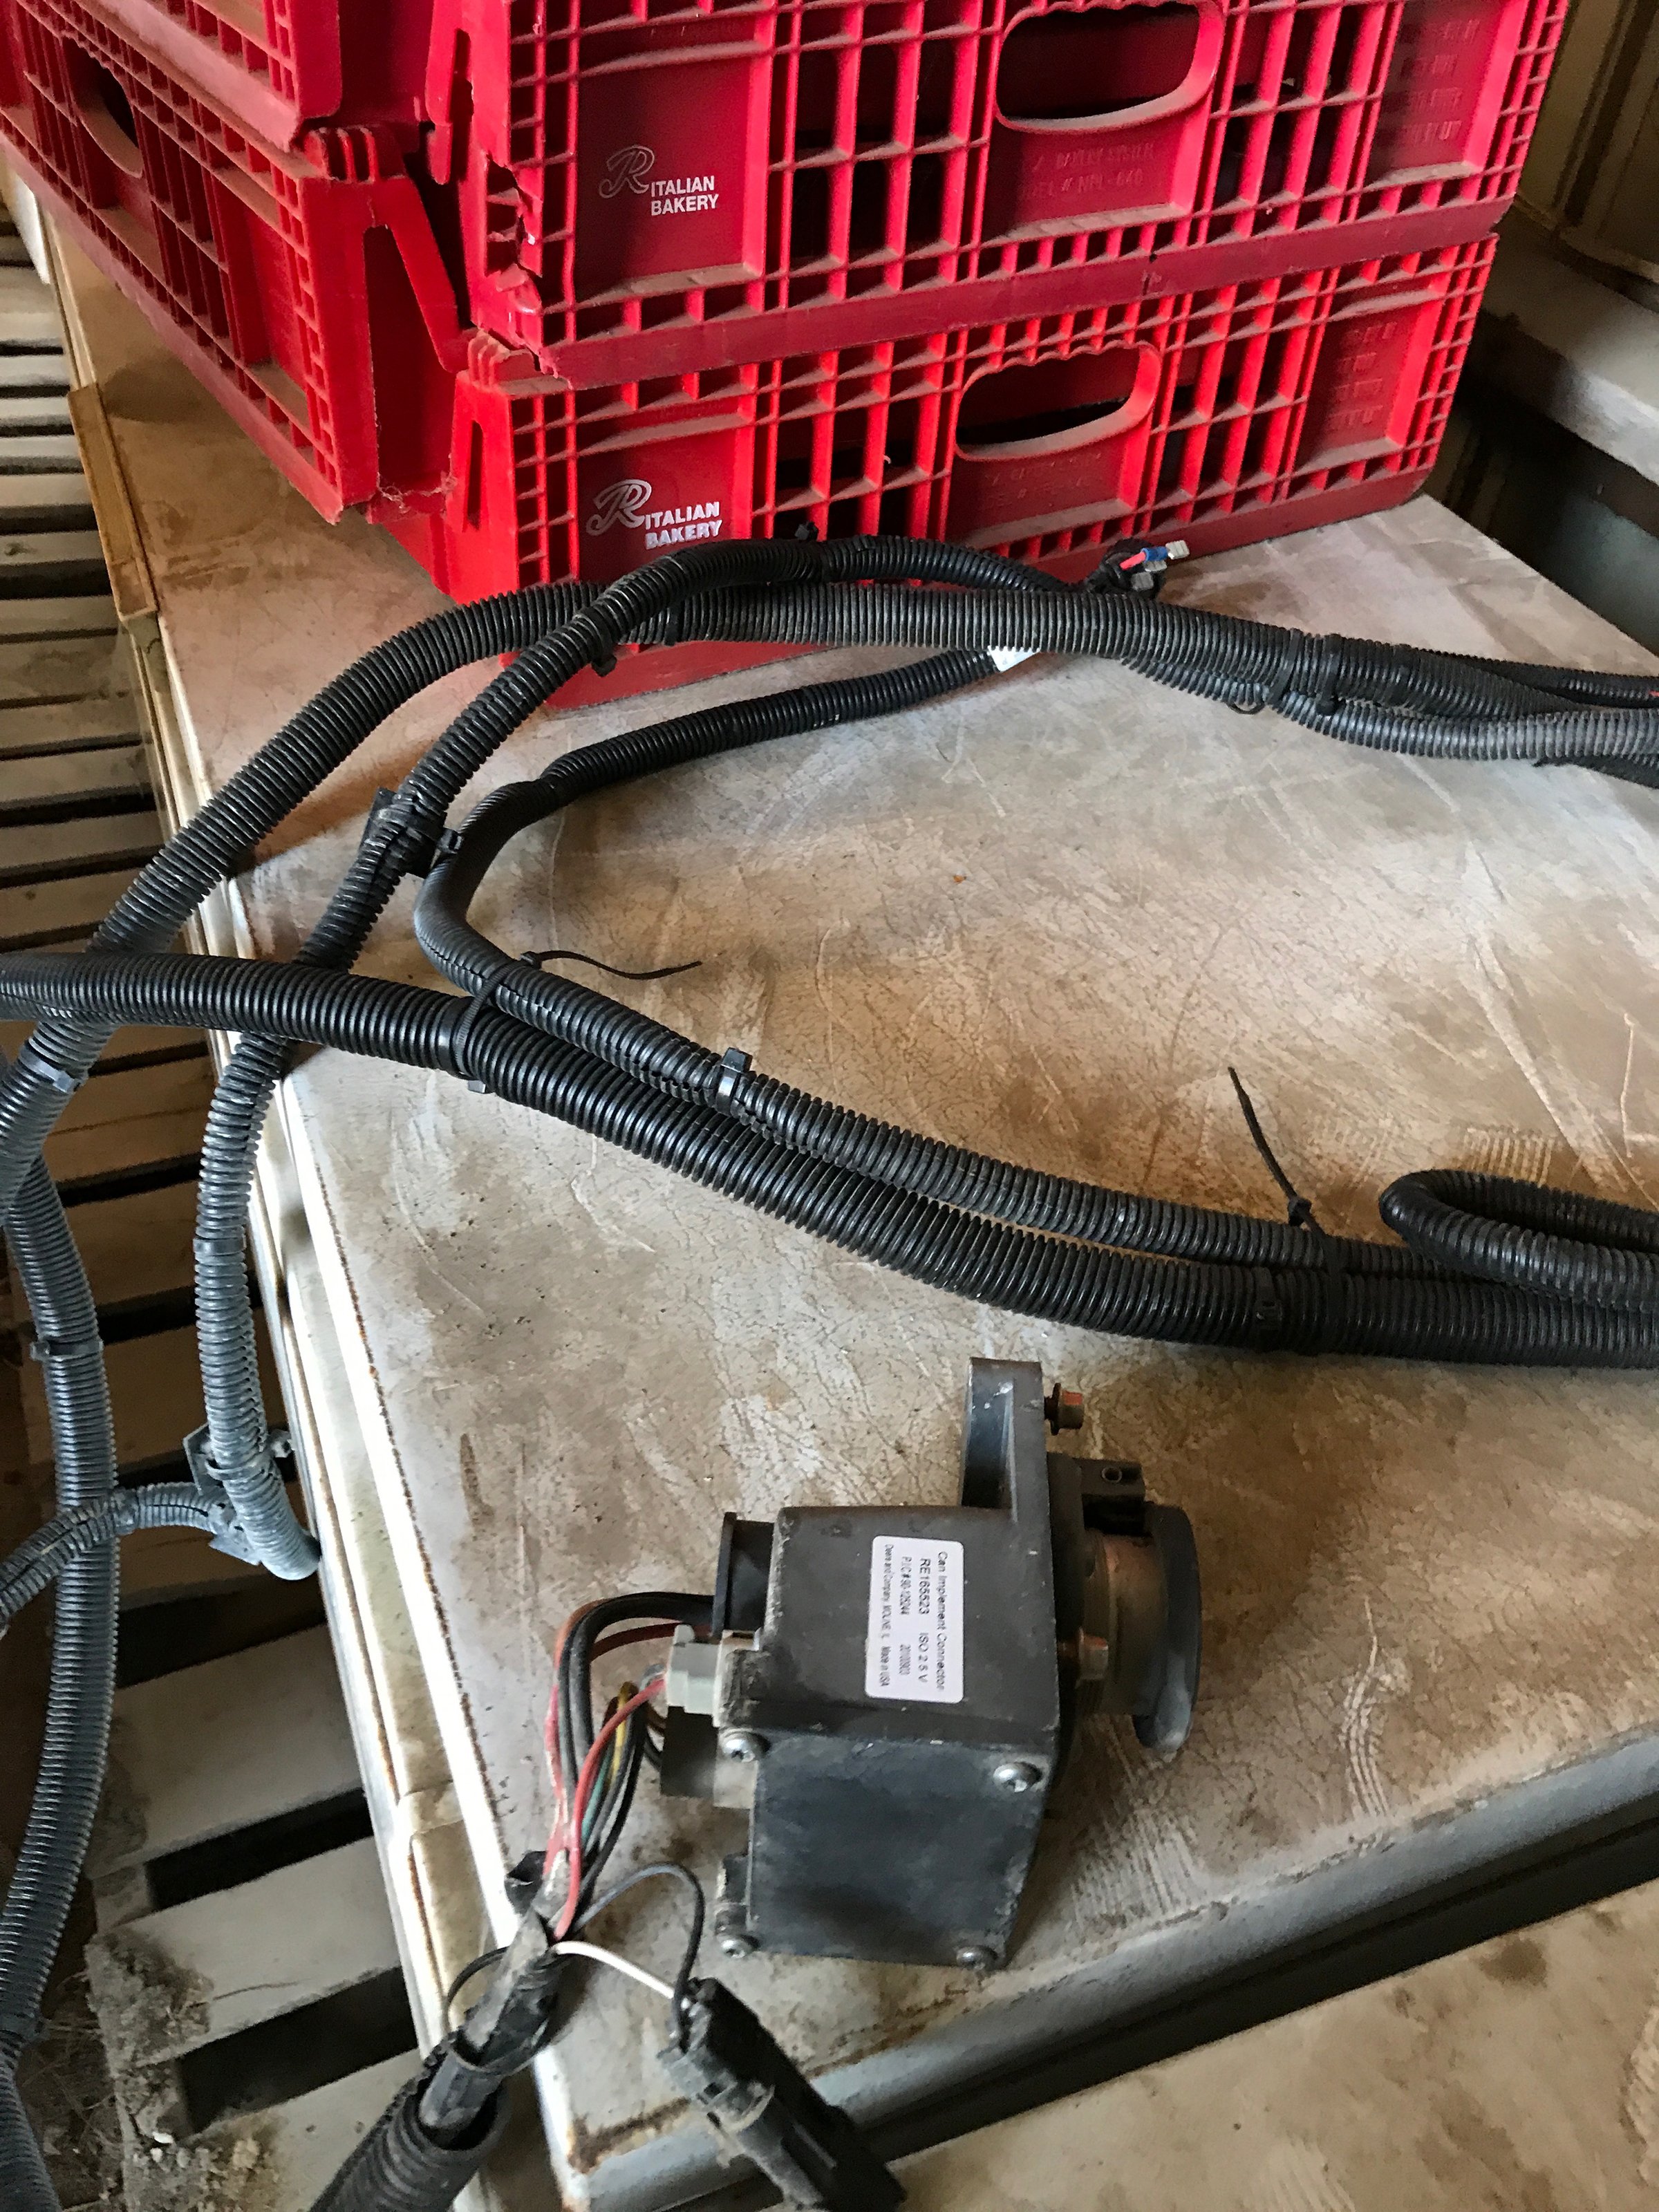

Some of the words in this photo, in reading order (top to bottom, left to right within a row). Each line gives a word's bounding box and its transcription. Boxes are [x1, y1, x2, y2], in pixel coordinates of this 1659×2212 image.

[651, 176, 715, 197] ITALIAN
[651, 194, 719, 216] BAKERY
[645, 501, 720, 529] ITALIAN
[645, 520, 722, 550] BAKERY
[937, 1551, 948, 1573] Can
[918, 1557, 931, 1615] RE165523
[936, 1575, 948, 1630] Implement
[918, 1632, 929, 1652] ISO
[936, 1633, 947, 1690] Connector
